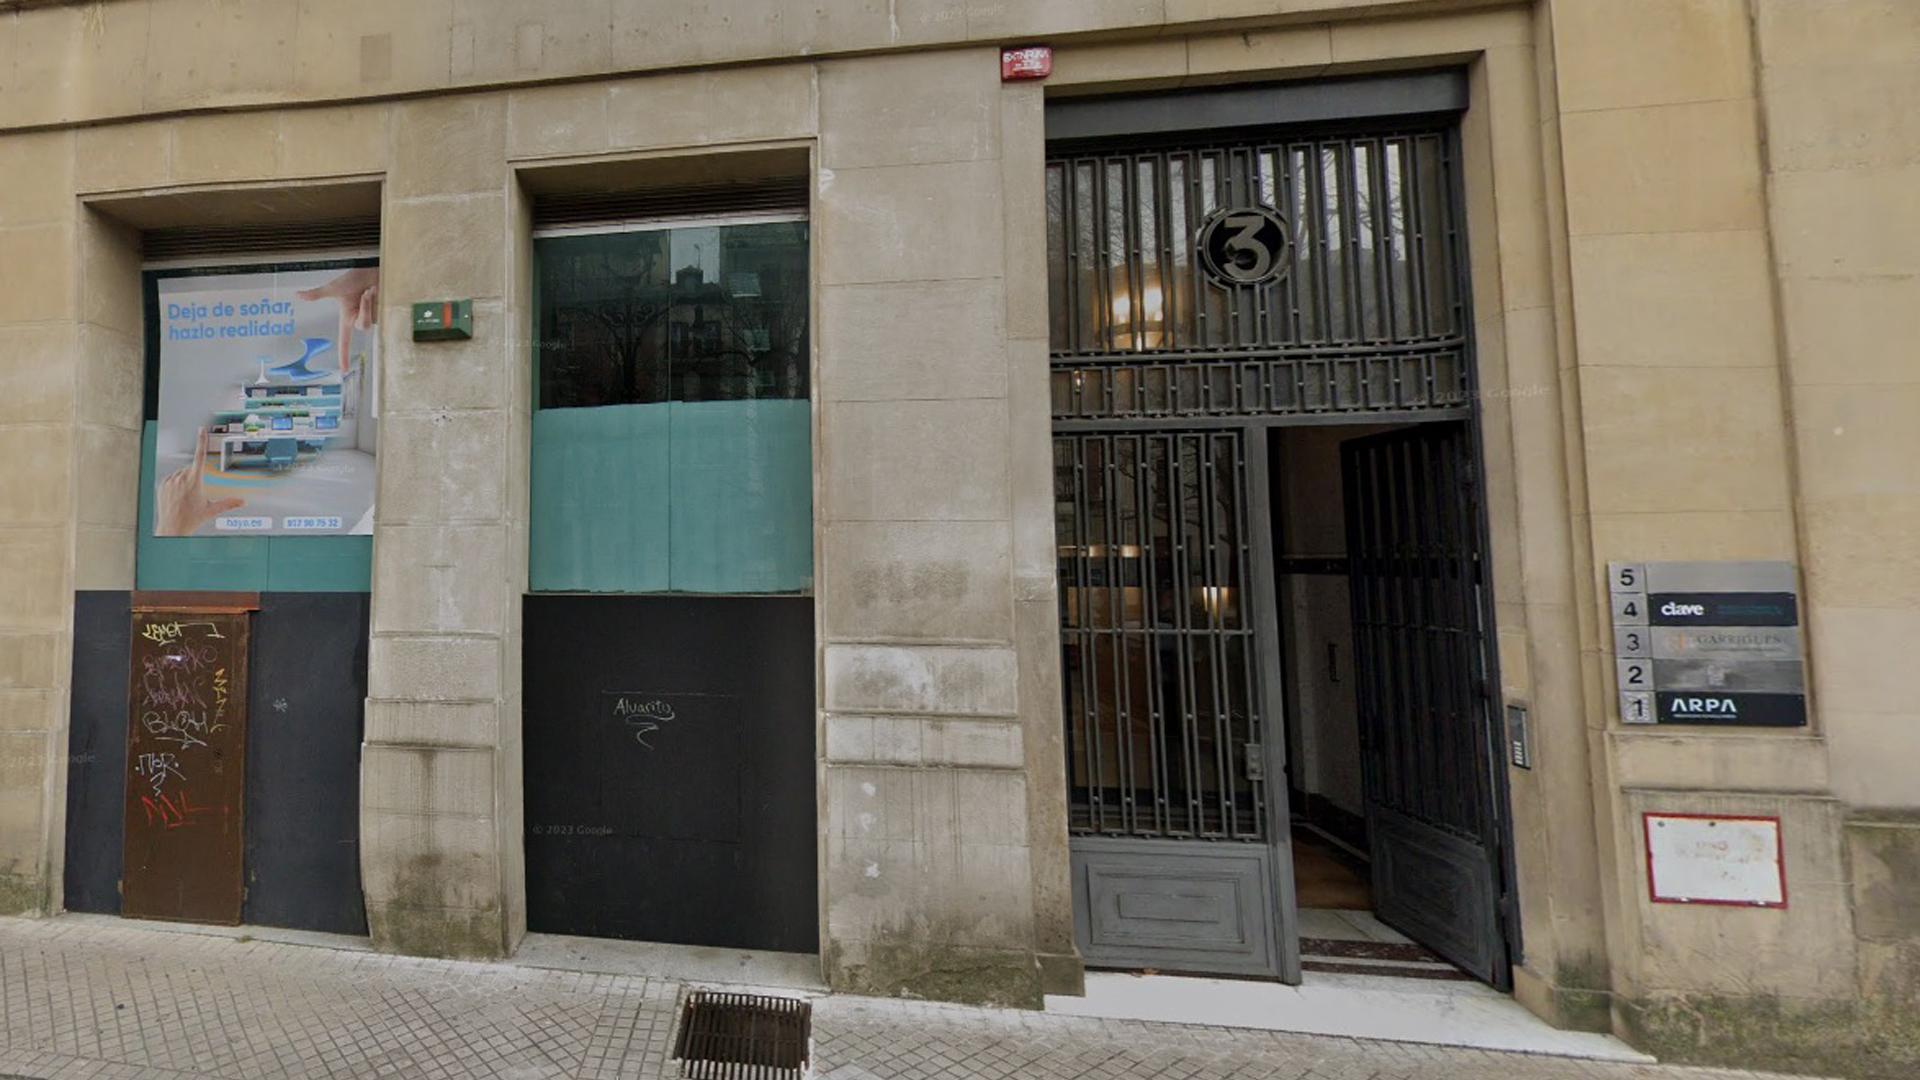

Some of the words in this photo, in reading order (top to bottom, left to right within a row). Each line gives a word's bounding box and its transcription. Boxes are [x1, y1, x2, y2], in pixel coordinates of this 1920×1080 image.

[1223, 215, 1271, 280] 3
[168, 302, 208, 321] Deja
[213, 301, 234, 317] de
[240, 299, 294, 317] soñar,
[169, 322, 215, 340] hazlo
[219, 319, 295, 337] realidad
[1620, 568, 1634, 586] 5
[1623, 601, 1638, 617] 4
[1661, 602, 1704, 616] clave
[1626, 633, 1640, 651] 3
[1628, 666, 1643, 684] 2
[1631, 699, 1643, 717] 1
[1671, 698, 1738, 713] ARPA
